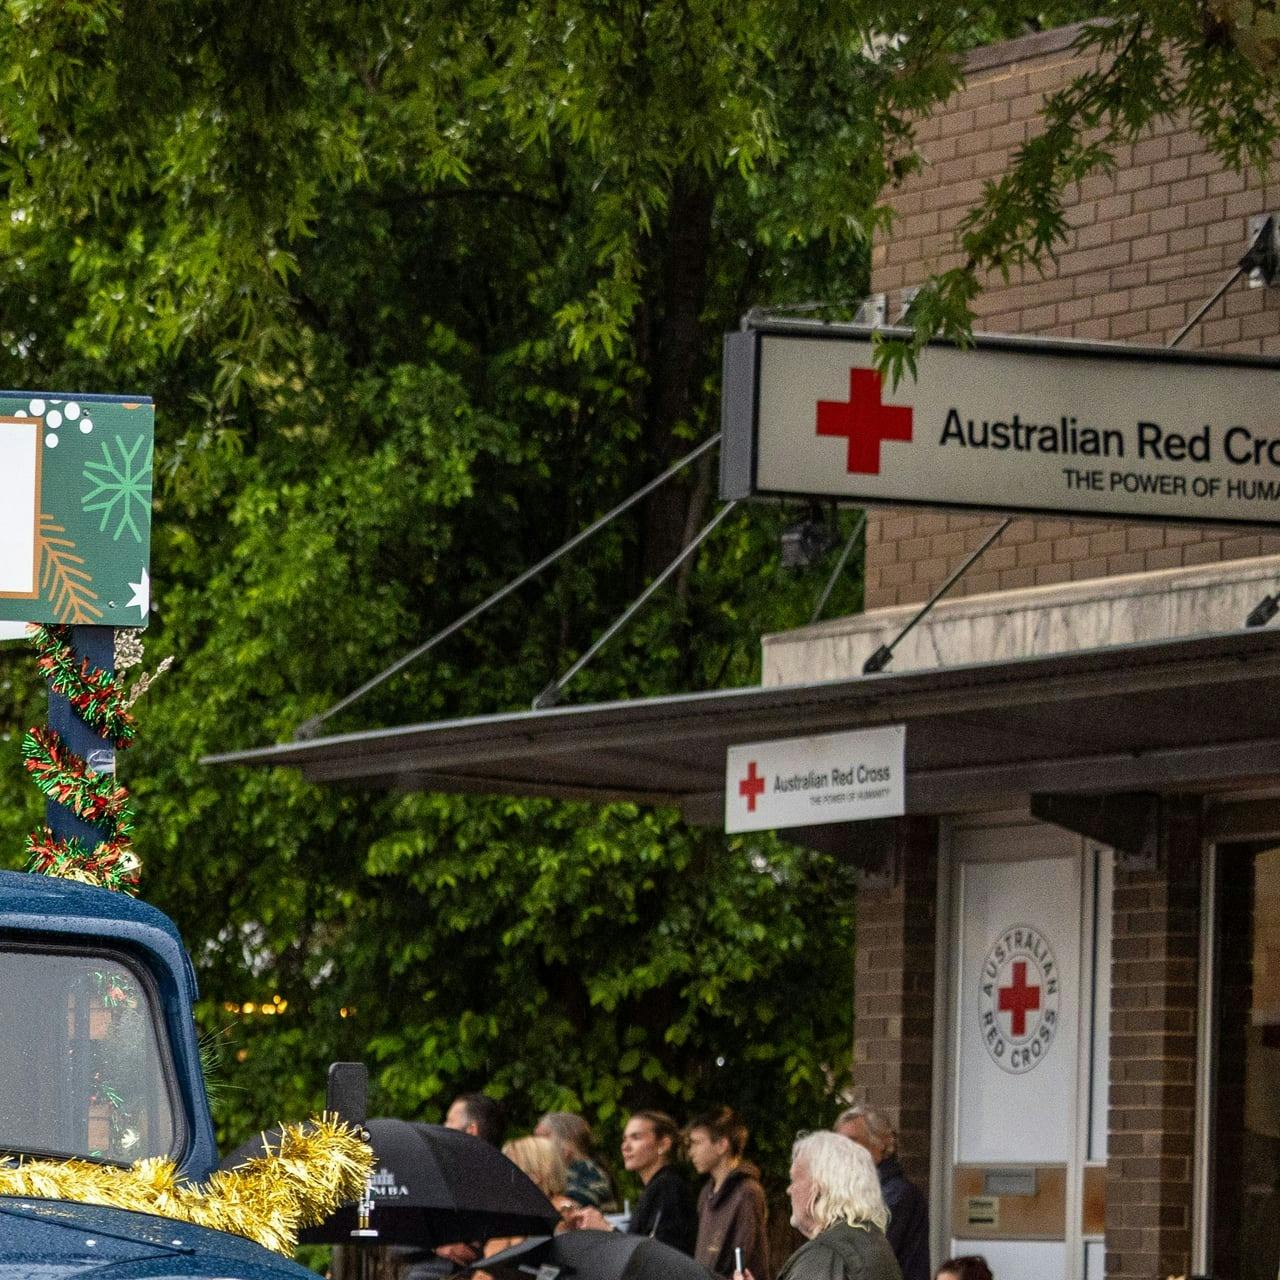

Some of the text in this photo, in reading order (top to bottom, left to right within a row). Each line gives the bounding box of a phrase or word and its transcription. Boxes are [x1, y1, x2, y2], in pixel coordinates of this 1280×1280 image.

[939, 408, 1125, 458] Australian
[1137, 421, 1211, 463] Red
[1062, 468, 1105, 491] THE
[1109, 471, 1187, 496] POWER
[1192, 476, 1219, 498] OF
[773, 763, 890, 794] Australian Red Cross
[983, 929, 1057, 997] AUSTRALIAN
[983, 1008, 1056, 1069] RED CROSS
